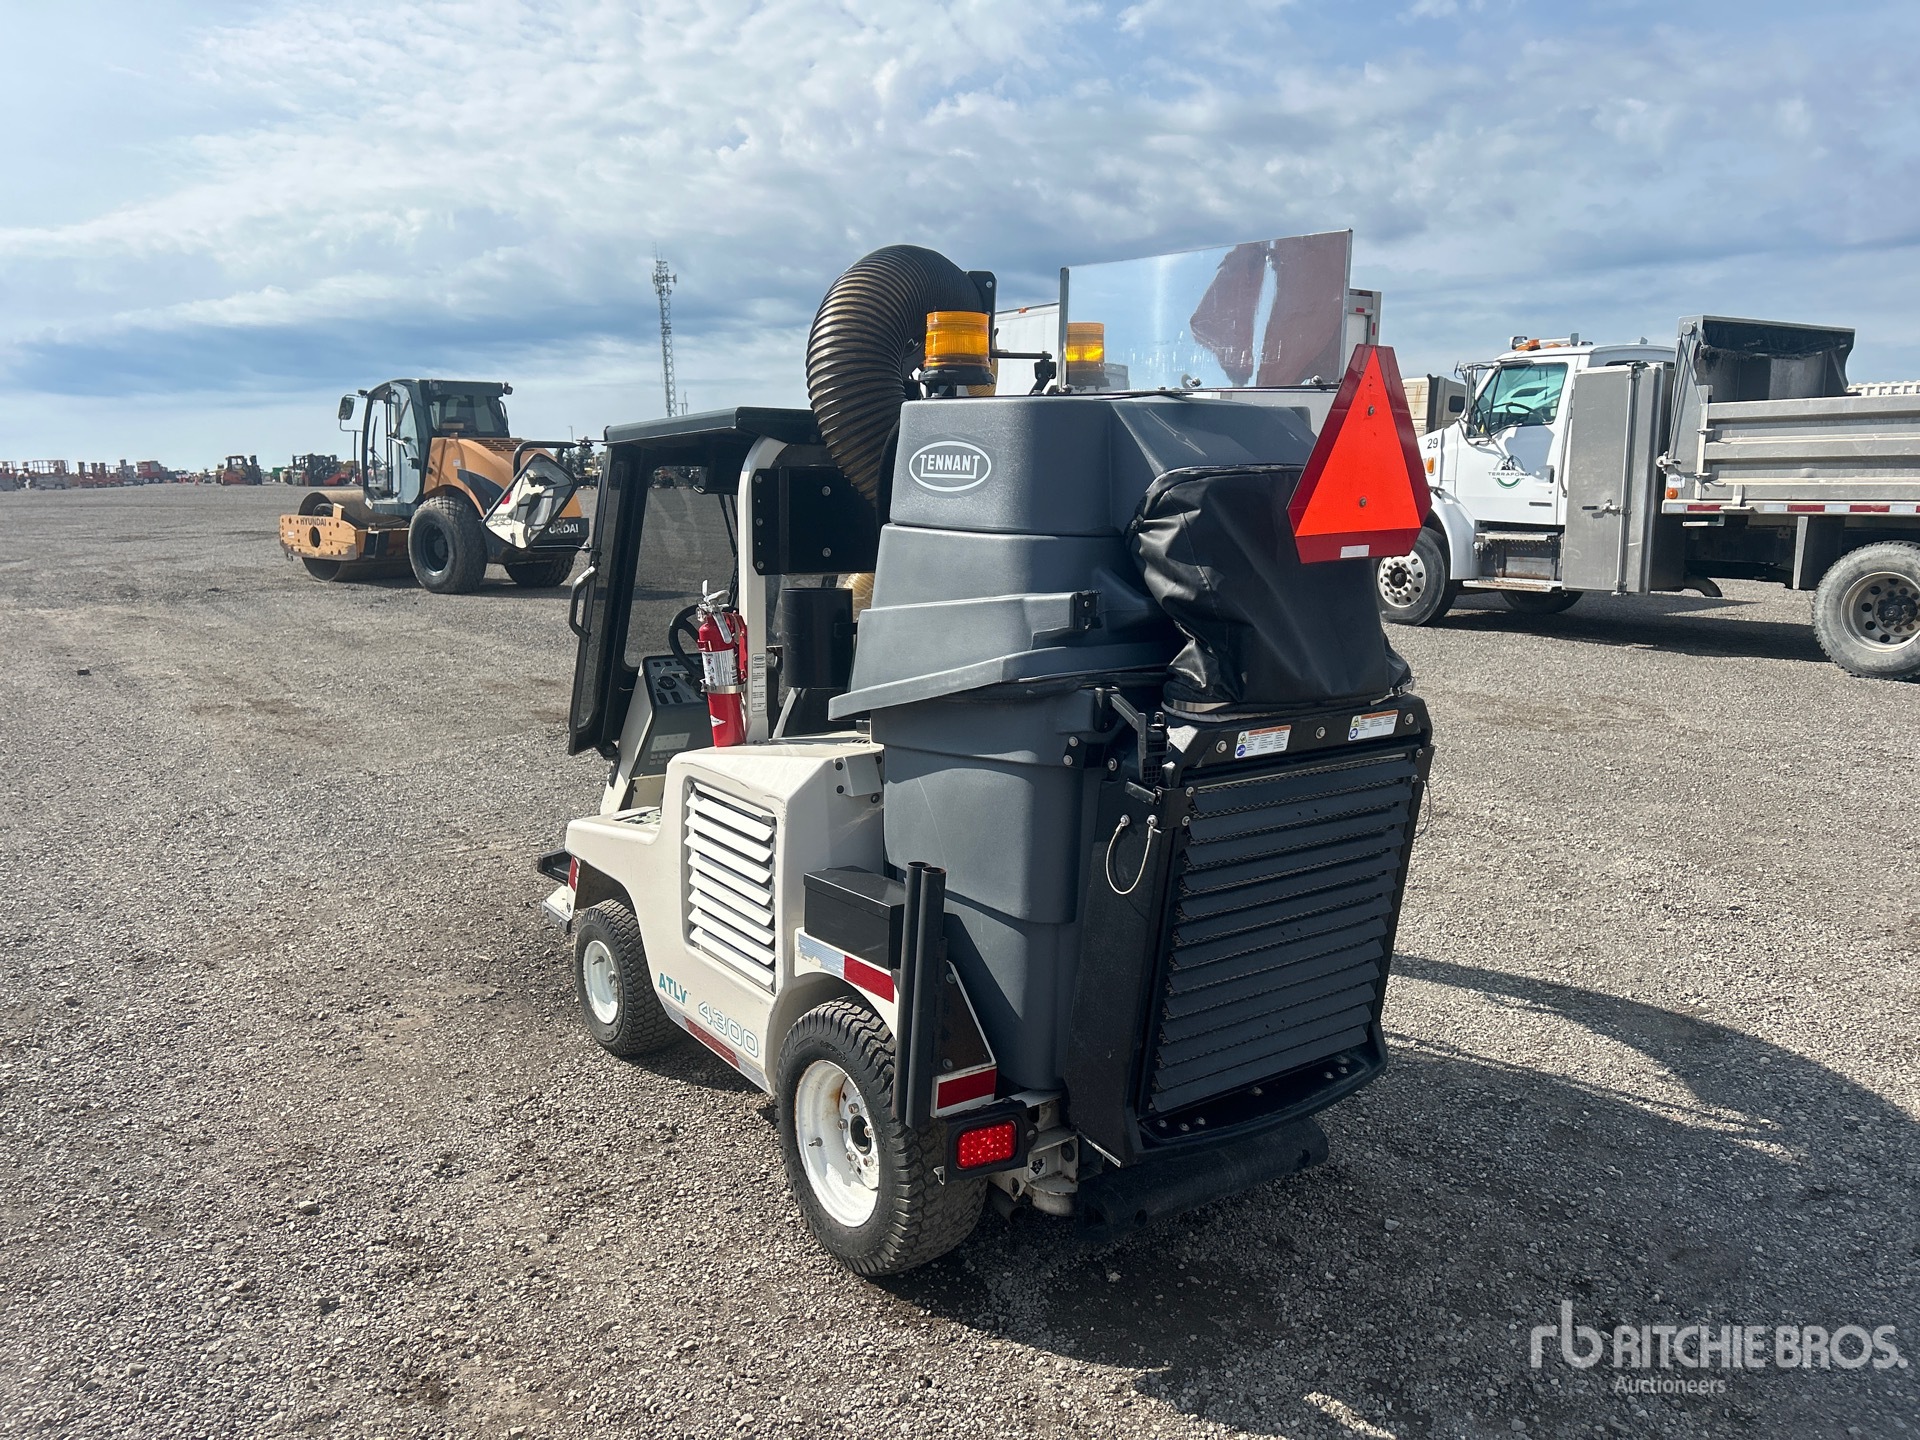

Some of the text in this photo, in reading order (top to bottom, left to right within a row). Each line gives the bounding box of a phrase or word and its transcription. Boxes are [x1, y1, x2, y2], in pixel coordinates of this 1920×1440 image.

[1427, 437, 1439, 450] 29
[919, 454, 981, 479] TENNANT
[300, 517, 327, 527] HYUNDAI
[658, 972, 688, 1005] ATLV
[698, 1000, 759, 1059] 4300
